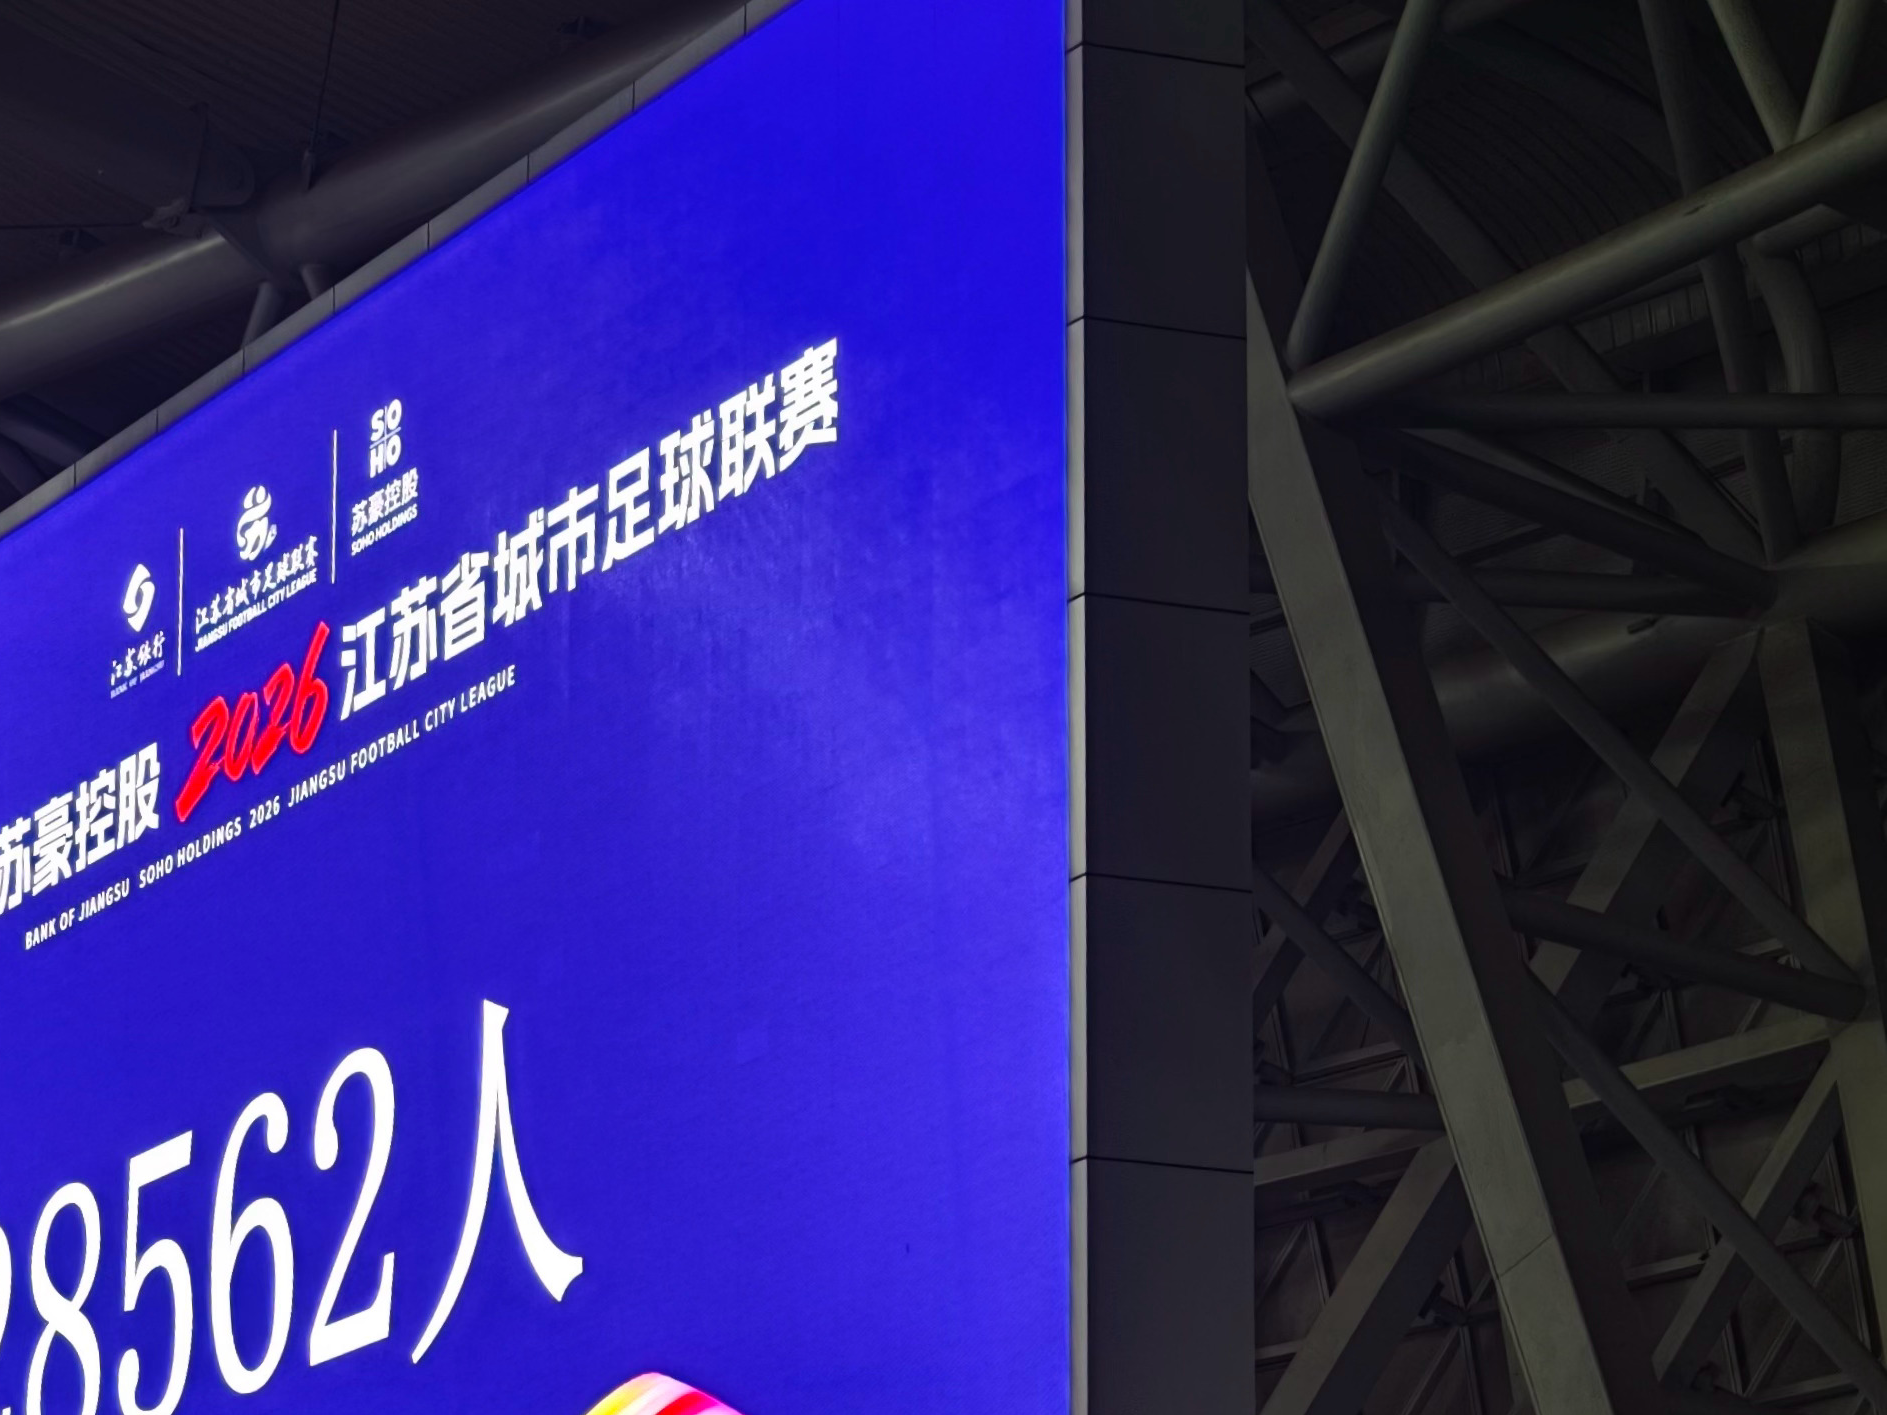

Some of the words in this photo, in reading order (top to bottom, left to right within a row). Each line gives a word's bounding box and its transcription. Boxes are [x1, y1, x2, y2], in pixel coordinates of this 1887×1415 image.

[351, 467, 419, 537] 苏豪控股
[351, 530, 374, 556] SOHO
[375, 503, 418, 542] HOLDINGS
[174, 620, 330, 823] 2026
[339, 337, 839, 721] 江苏省城市足球联赛
[229, 599, 267, 632] FOOTBALL
[267, 587, 285, 609] CITY
[286, 567, 318, 599] LEAGUE
[25, 918, 57, 951] BANK
[59, 907, 76, 931] OF
[78, 877, 130, 922] JIANGSU
[138, 854, 174, 889] SOHO
[176, 816, 242, 868] HOLDINGS
[249, 795, 281, 829] 2026
[287, 759, 346, 808] JIANGSU
[350, 719, 420, 774] FOOTBALL
[424, 697, 456, 732] CITY
[460, 664, 516, 713] LEAGUE
